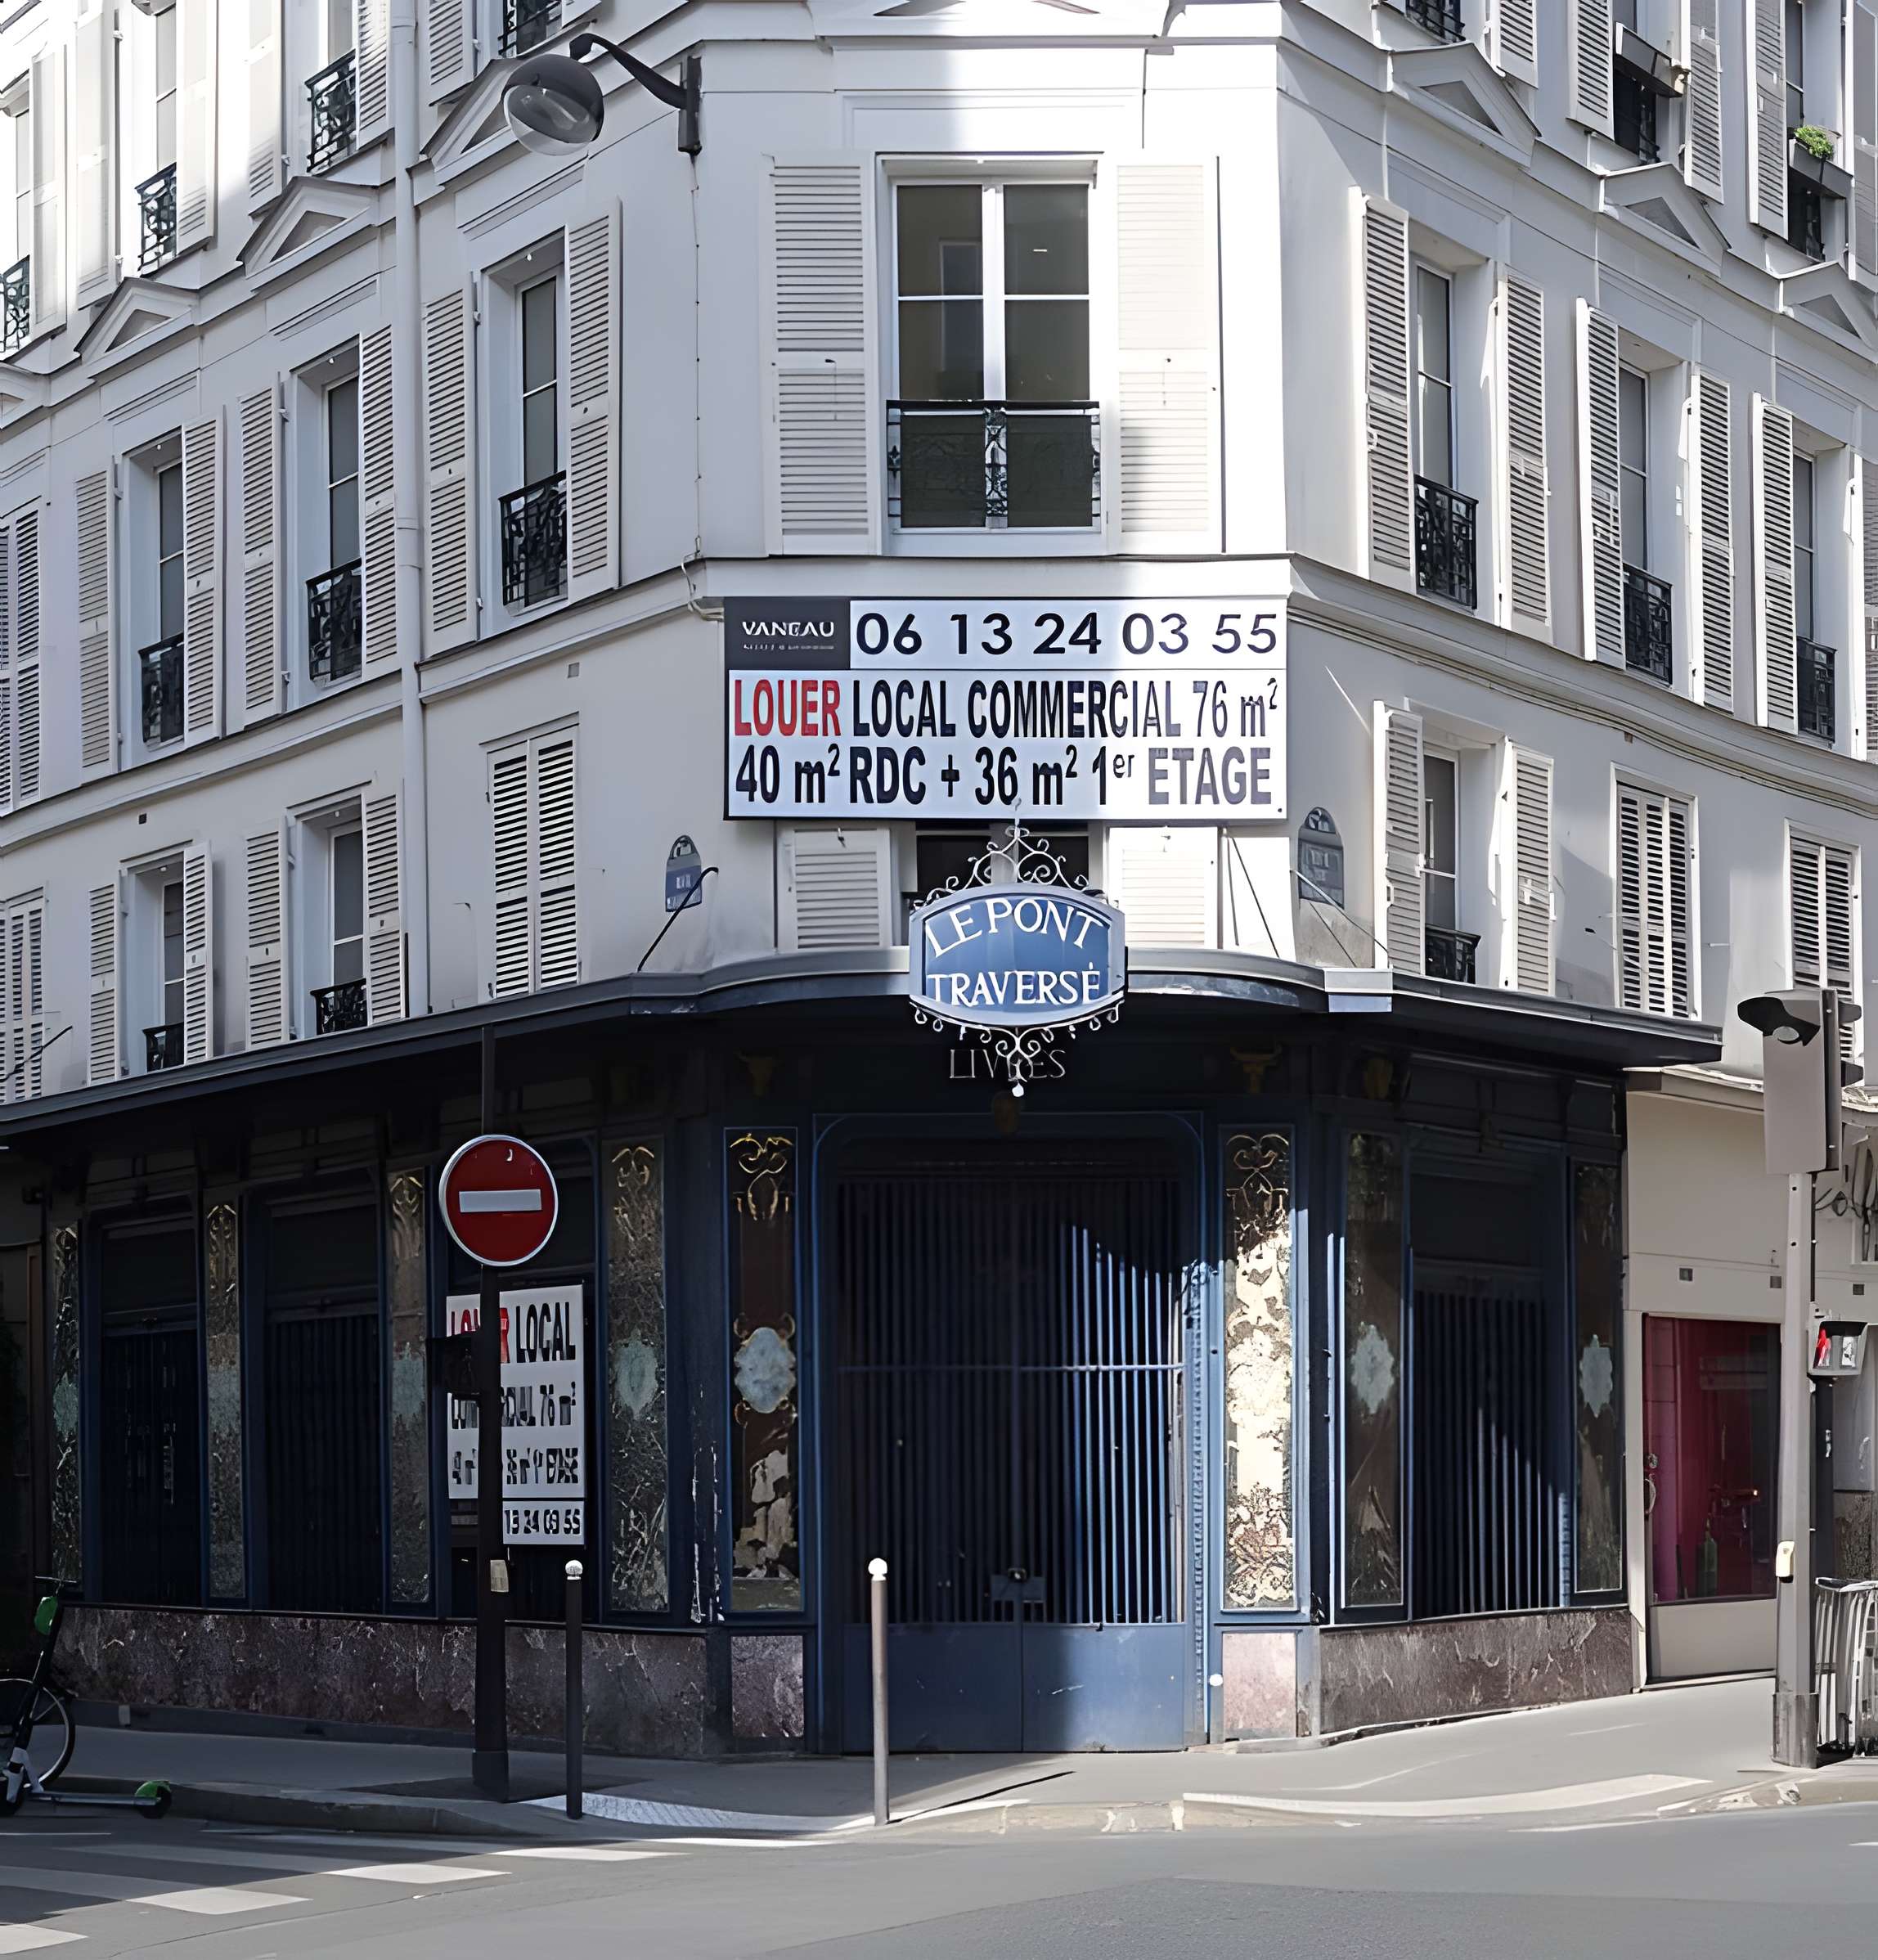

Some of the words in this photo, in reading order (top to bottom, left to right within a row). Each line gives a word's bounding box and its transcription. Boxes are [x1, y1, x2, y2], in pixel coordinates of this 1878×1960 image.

[856, 612, 923, 655] 06
[950, 612, 1013, 655] 13
[1032, 612, 1102, 654] 24
[1121, 612, 1189, 655] 03
[1211, 614, 1277, 654] 55
[734, 678, 842, 737] LOUER
[852, 679, 956, 738] LOCAL
[967, 679, 1180, 739] COMMERCIAL
[1193, 680, 1229, 738] 76
[735, 744, 780, 804] 40
[849, 745, 926, 805] RDC
[941, 753, 960, 798] +
[974, 746, 1018, 805] 36
[1148, 746, 1272, 805] ETAGE
[925, 903, 982, 959] LE
[985, 897, 1104, 949] PONT
[949, 1049, 1066, 1079] LIVES
[515, 1301, 577, 1364] LOCAL
